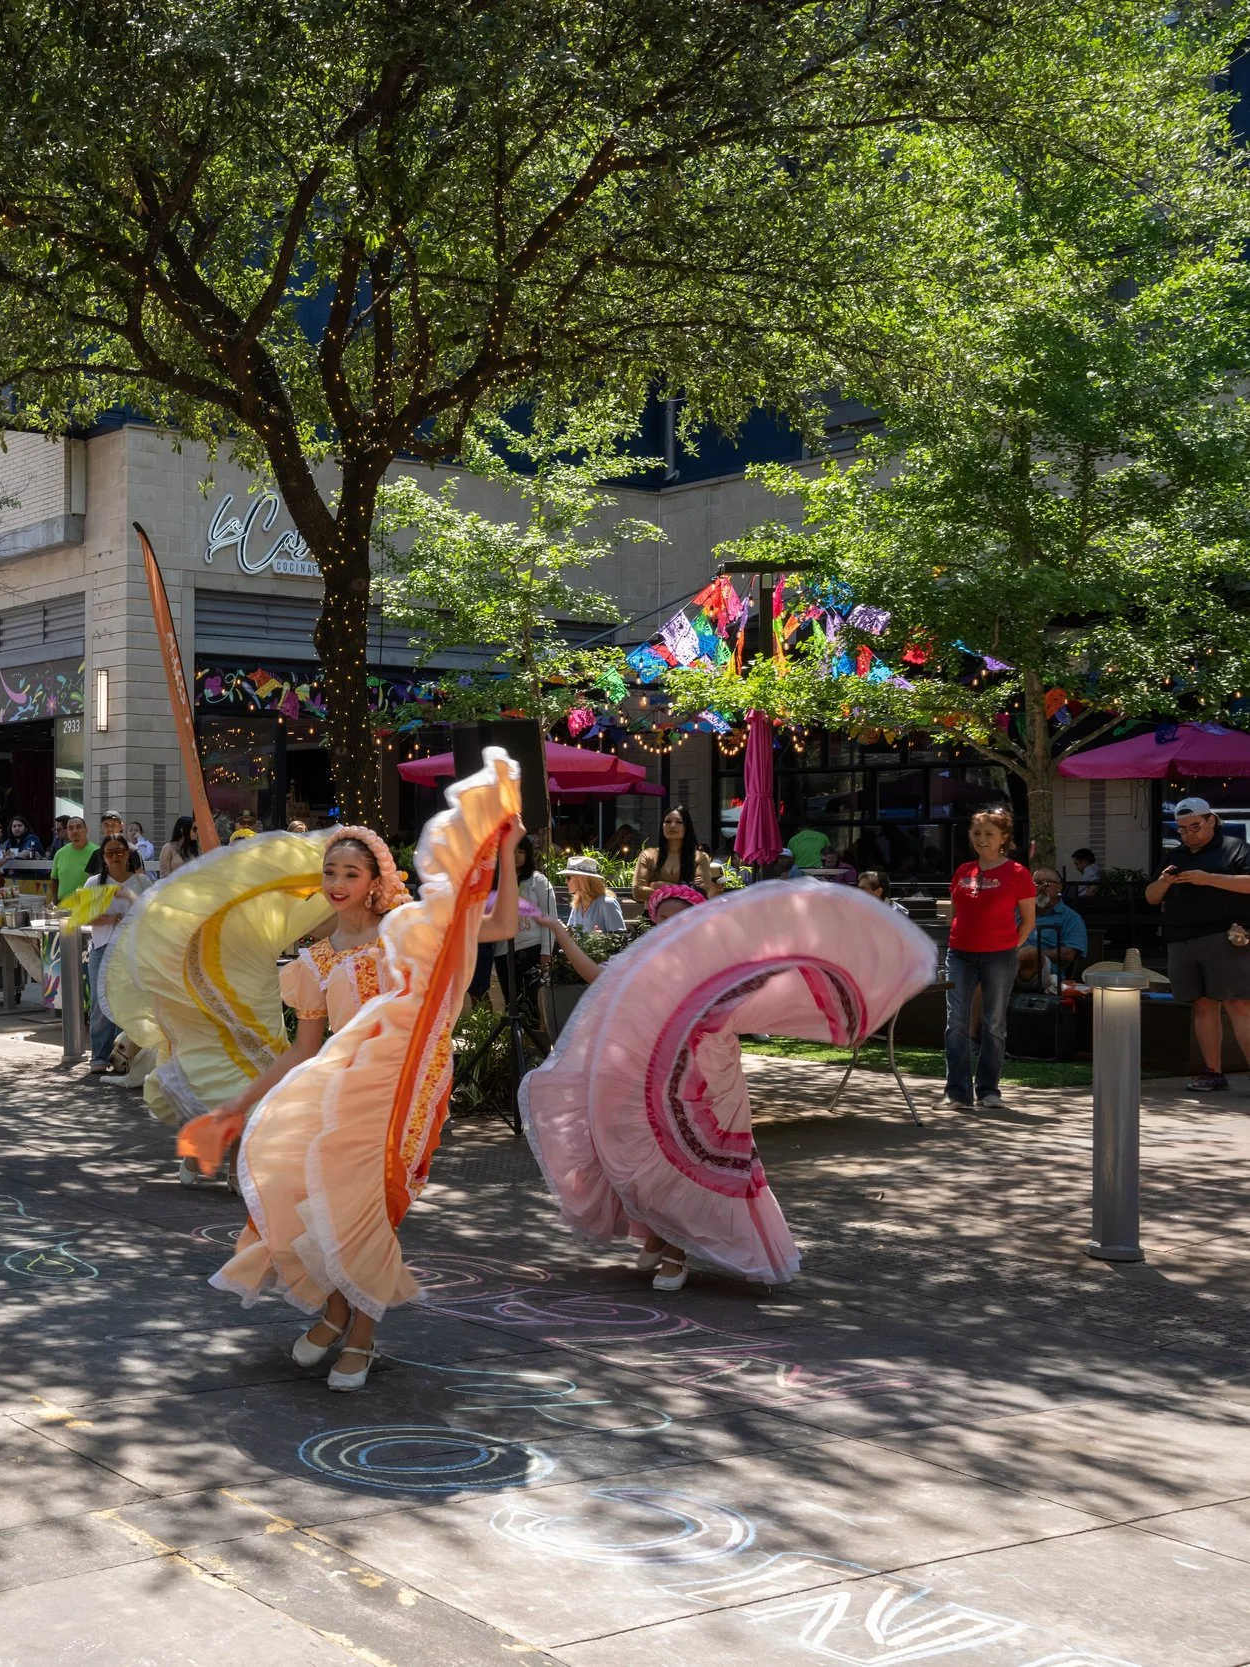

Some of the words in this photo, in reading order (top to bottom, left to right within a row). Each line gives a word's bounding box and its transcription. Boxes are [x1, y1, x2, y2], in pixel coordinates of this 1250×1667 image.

[205, 494, 243, 563] La
[238, 490, 311, 574] Cas
[62, 719, 80, 734] 2933
